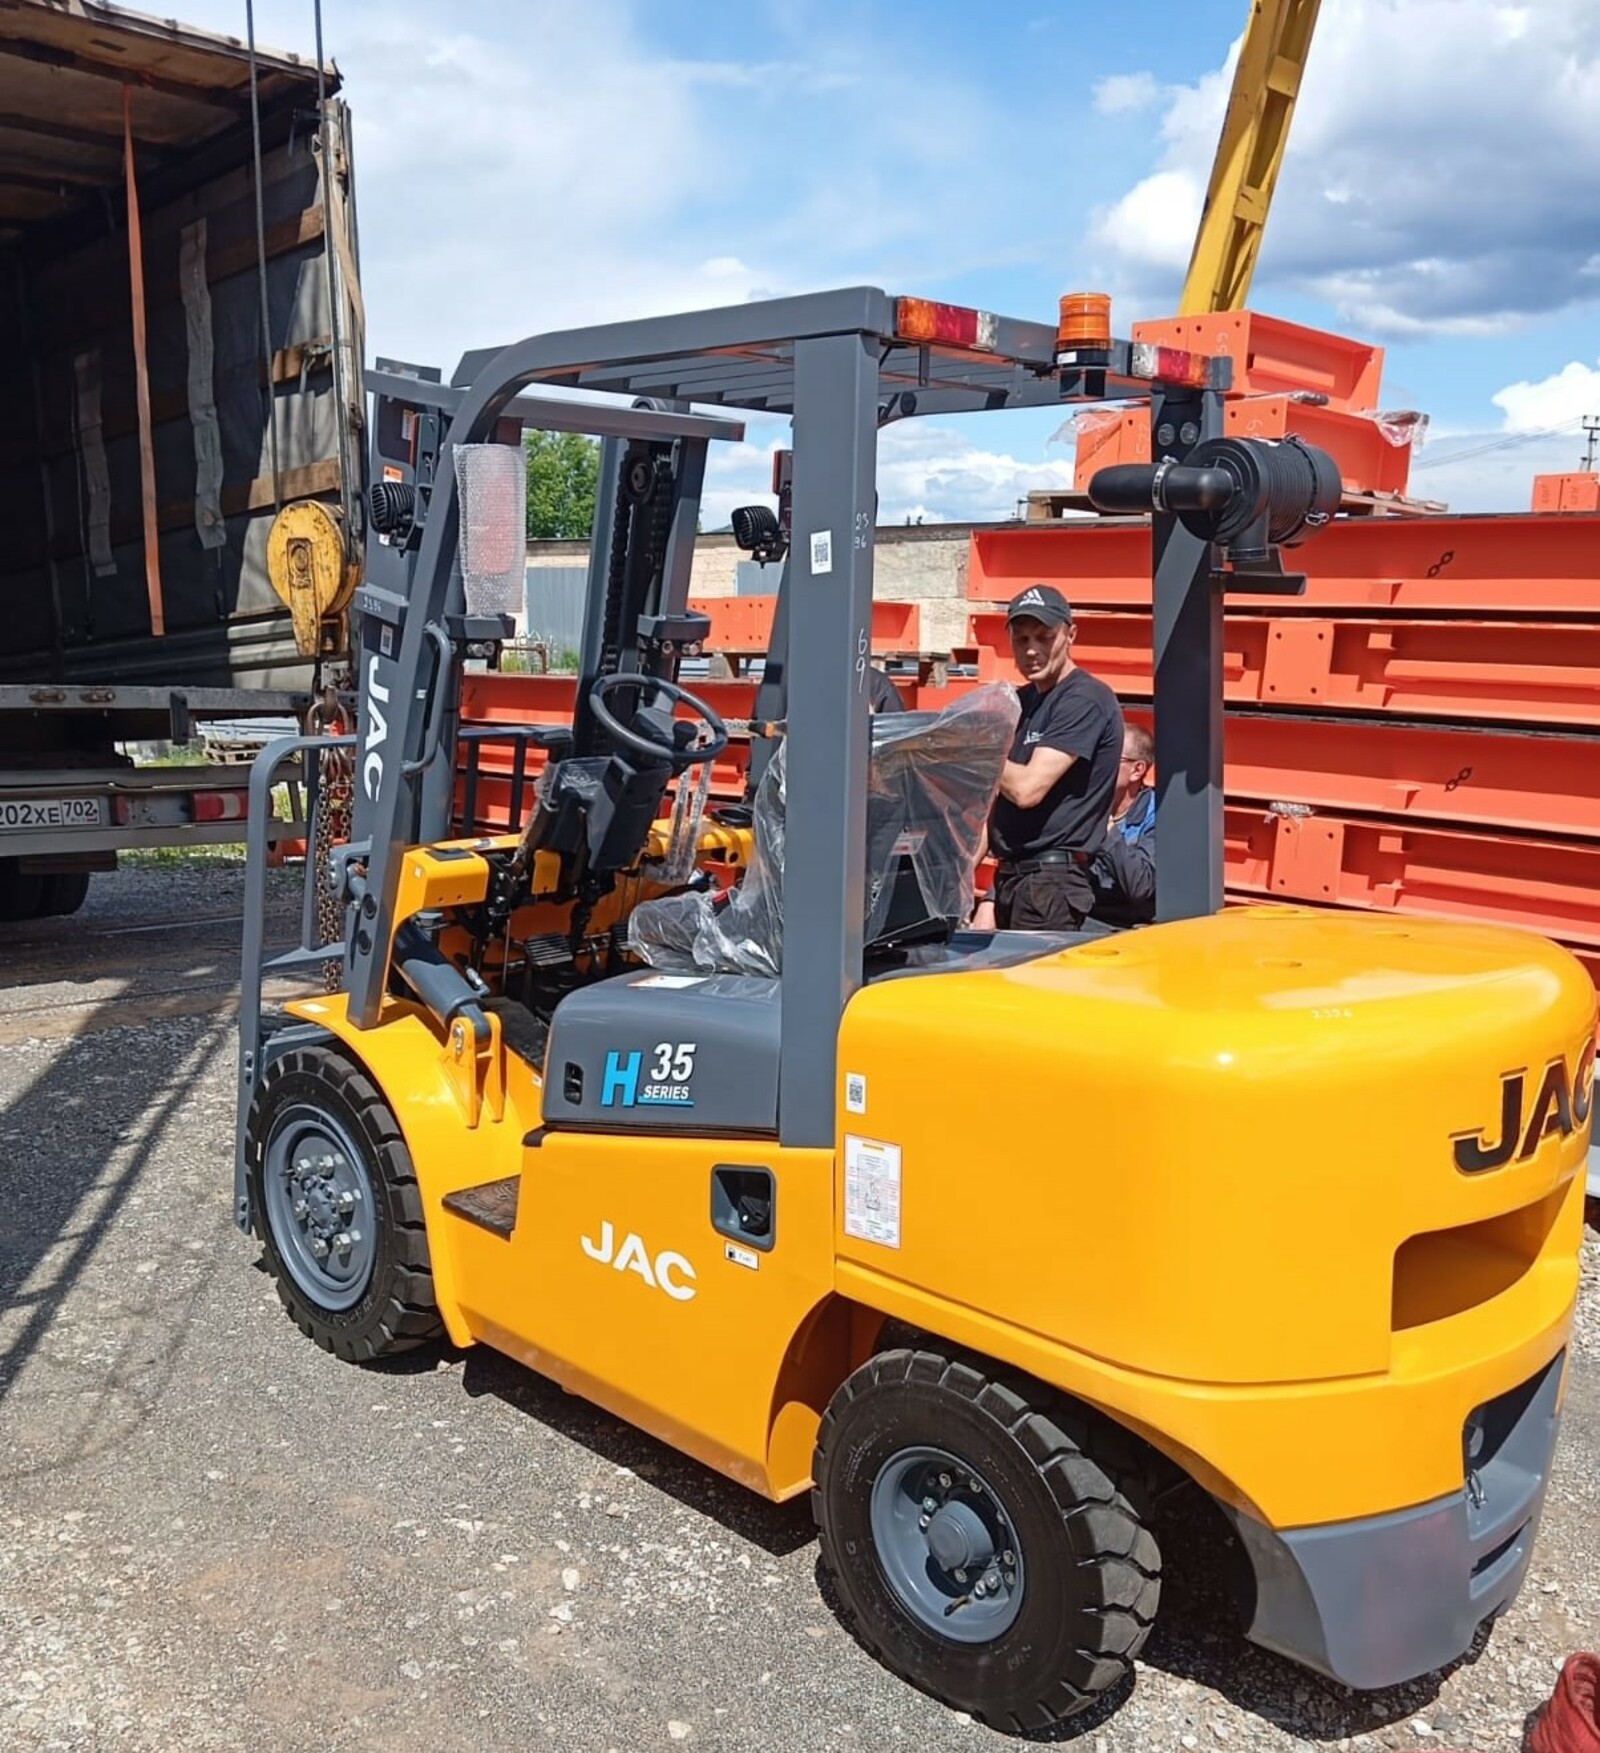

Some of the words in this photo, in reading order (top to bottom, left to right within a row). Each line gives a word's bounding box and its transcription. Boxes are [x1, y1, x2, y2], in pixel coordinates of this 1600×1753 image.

[364, 655, 390, 803] JAC
[63, 801, 94, 817] 702
[601, 1051, 642, 1106] H
[650, 1042, 696, 1081] 35
[643, 1084, 690, 1100] SERIES
[1452, 1036, 1597, 1174] JAC
[581, 1220, 697, 1301] JAC
